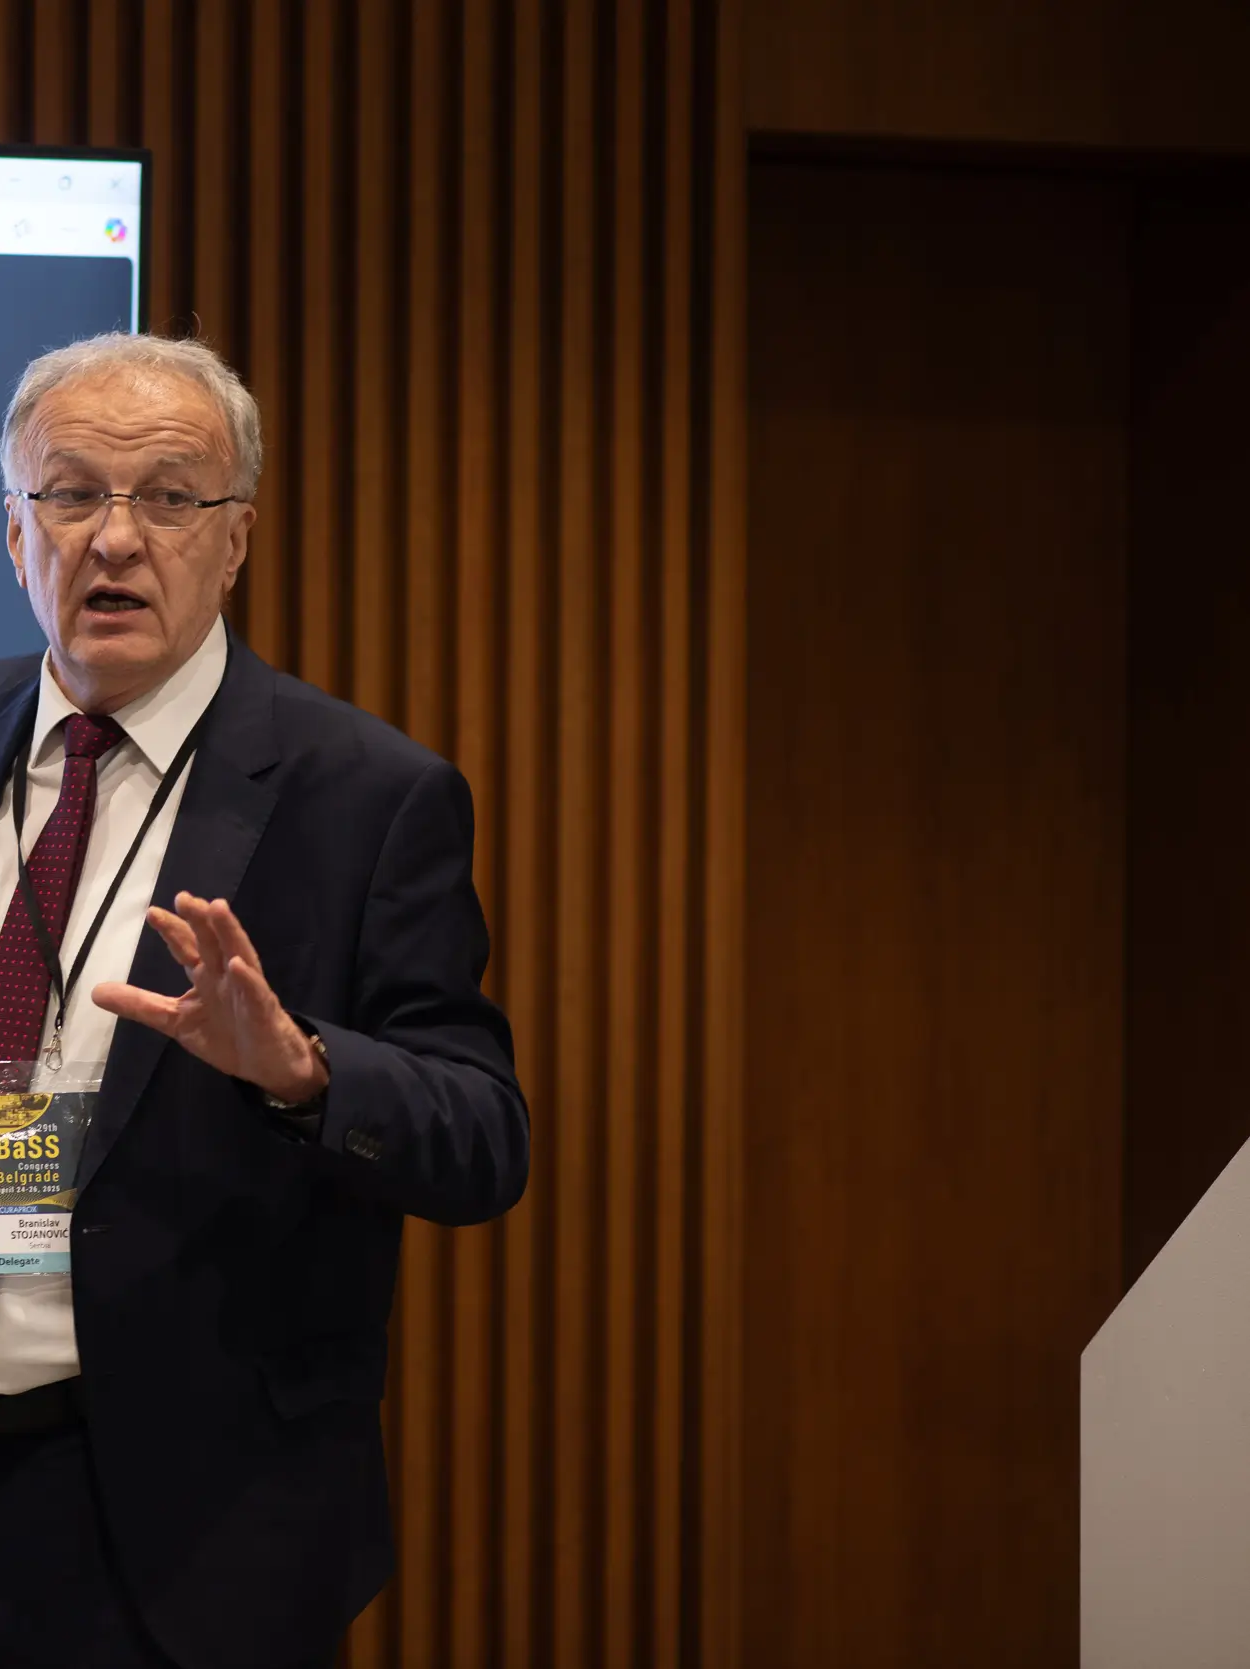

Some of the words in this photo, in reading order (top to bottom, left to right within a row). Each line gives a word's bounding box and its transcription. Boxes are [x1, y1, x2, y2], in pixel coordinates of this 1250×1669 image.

[18, 1162, 60, 1171] Congress
[42, 1184, 60, 1193] 2025
[18, 1218, 60, 1228] Branislav
[10, 1227, 69, 1240] STOJANOVIĆ
